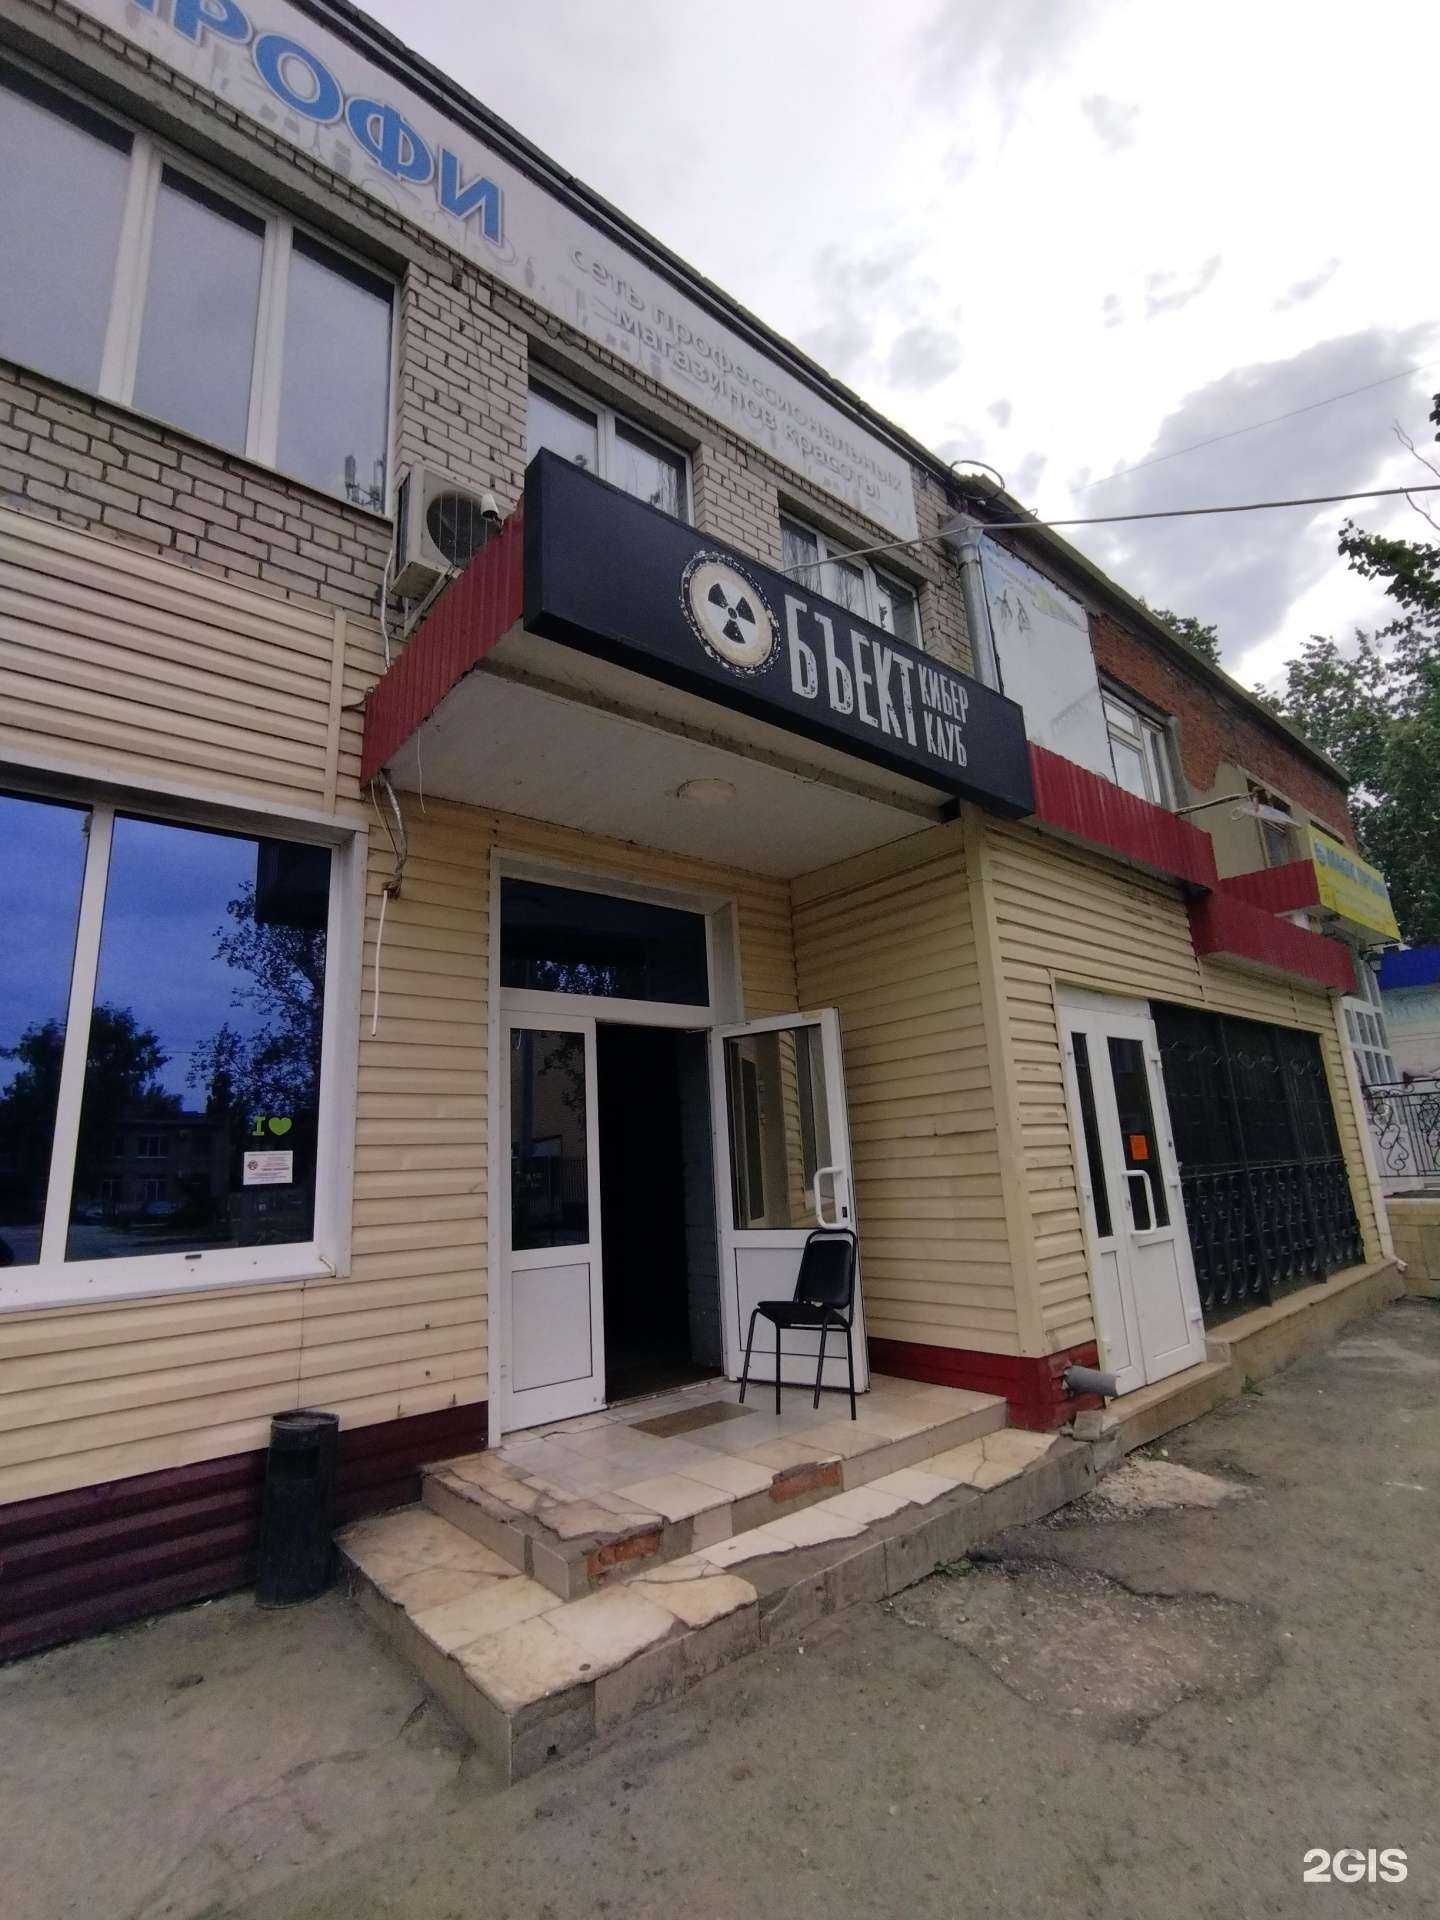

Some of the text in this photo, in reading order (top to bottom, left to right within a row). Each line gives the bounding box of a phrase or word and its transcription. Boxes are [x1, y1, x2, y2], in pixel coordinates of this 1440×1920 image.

[133, 0, 504, 245] РОФИ
[572, 249, 646, 312] сеть
[616, 306, 880, 499] магазинов красоты
[918, 663, 969, 723] КИБЕР
[924, 710, 968, 767] КЛУБ
